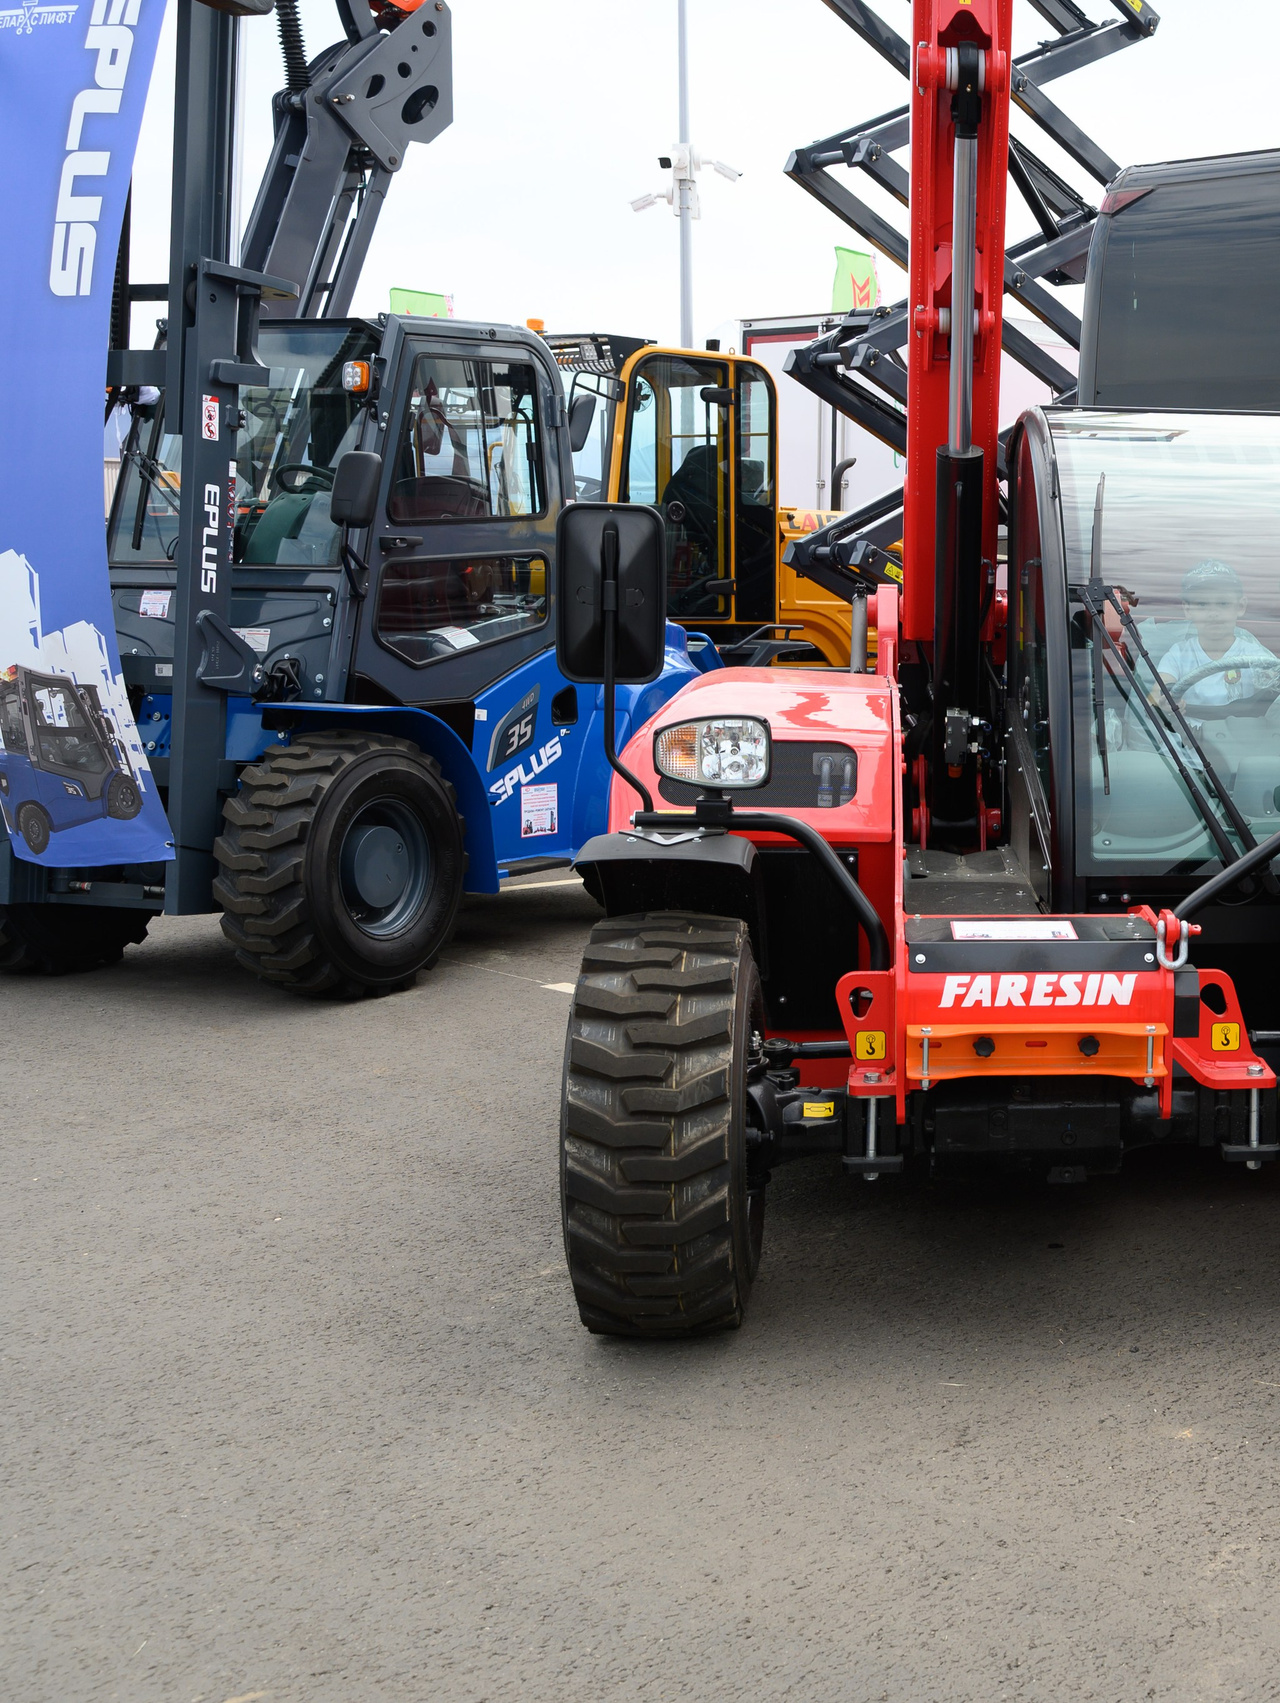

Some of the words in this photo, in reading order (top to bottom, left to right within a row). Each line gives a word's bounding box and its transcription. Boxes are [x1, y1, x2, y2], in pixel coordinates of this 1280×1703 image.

[200, 484, 220, 594] EPLUS
[522, 692, 535, 710] 4WD
[505, 713, 533, 756] 35
[489, 736, 563, 806] EPLUS
[938, 973, 1139, 1008] FARESIN
